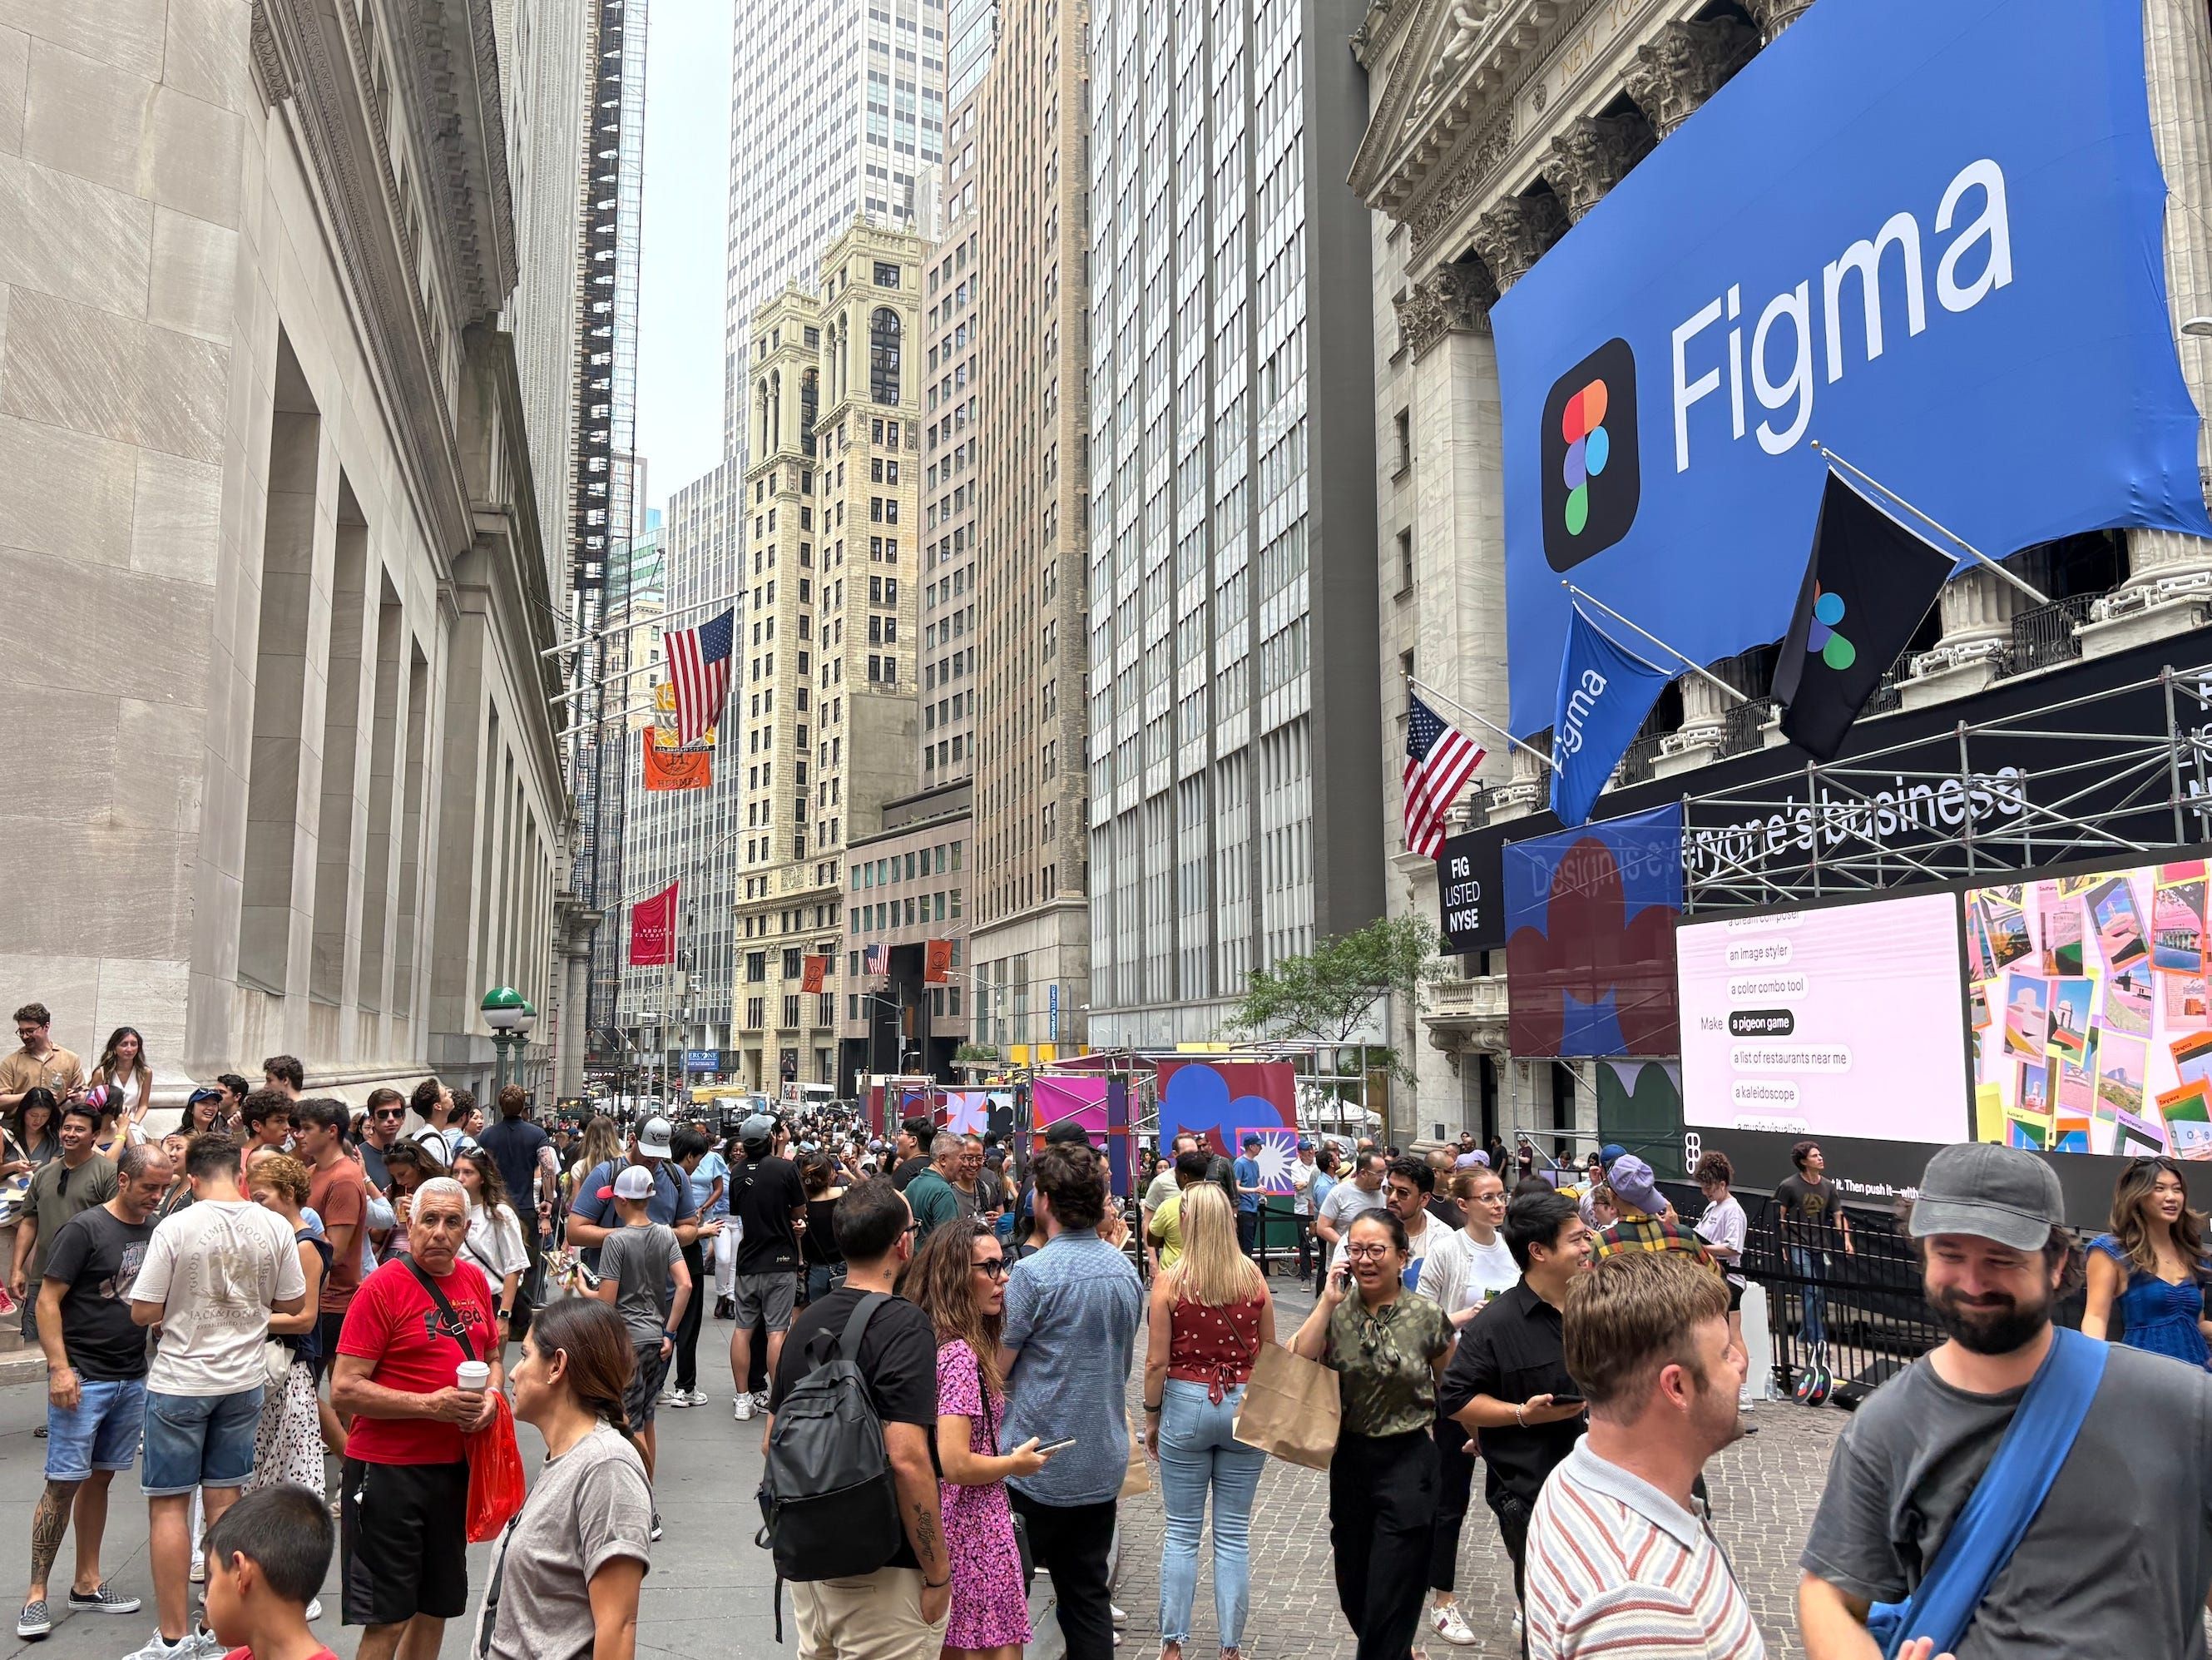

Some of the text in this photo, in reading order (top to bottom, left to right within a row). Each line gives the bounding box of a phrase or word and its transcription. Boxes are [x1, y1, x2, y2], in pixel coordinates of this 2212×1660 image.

[1561, 23, 1598, 87] NEW
[1670, 157, 2013, 474] Figma
[1532, 766, 2022, 899] Design is everyone's business
[1451, 856, 1470, 879] FIG
[1445, 880, 1481, 908] LISTED
[1450, 908, 1479, 933] NYSE
[1730, 944, 1788, 961] an image styler
[1731, 978, 1804, 994] a color combo tool
[1700, 1016, 1789, 1032] Make a pigeon game
[1734, 1051, 1847, 1064] a list of restaurants near me
[1735, 1086, 1794, 1103] a kaleidoscope
[1844, 1179, 1864, 1193] Then
[1865, 1183, 1886, 1196] push
[189, 1252, 200, 1289] GOOD
[197, 1222, 231, 1246] TIMES
[235, 1223, 268, 1249] GOOD
[190, 1309, 261, 1321] JACK&JONE
